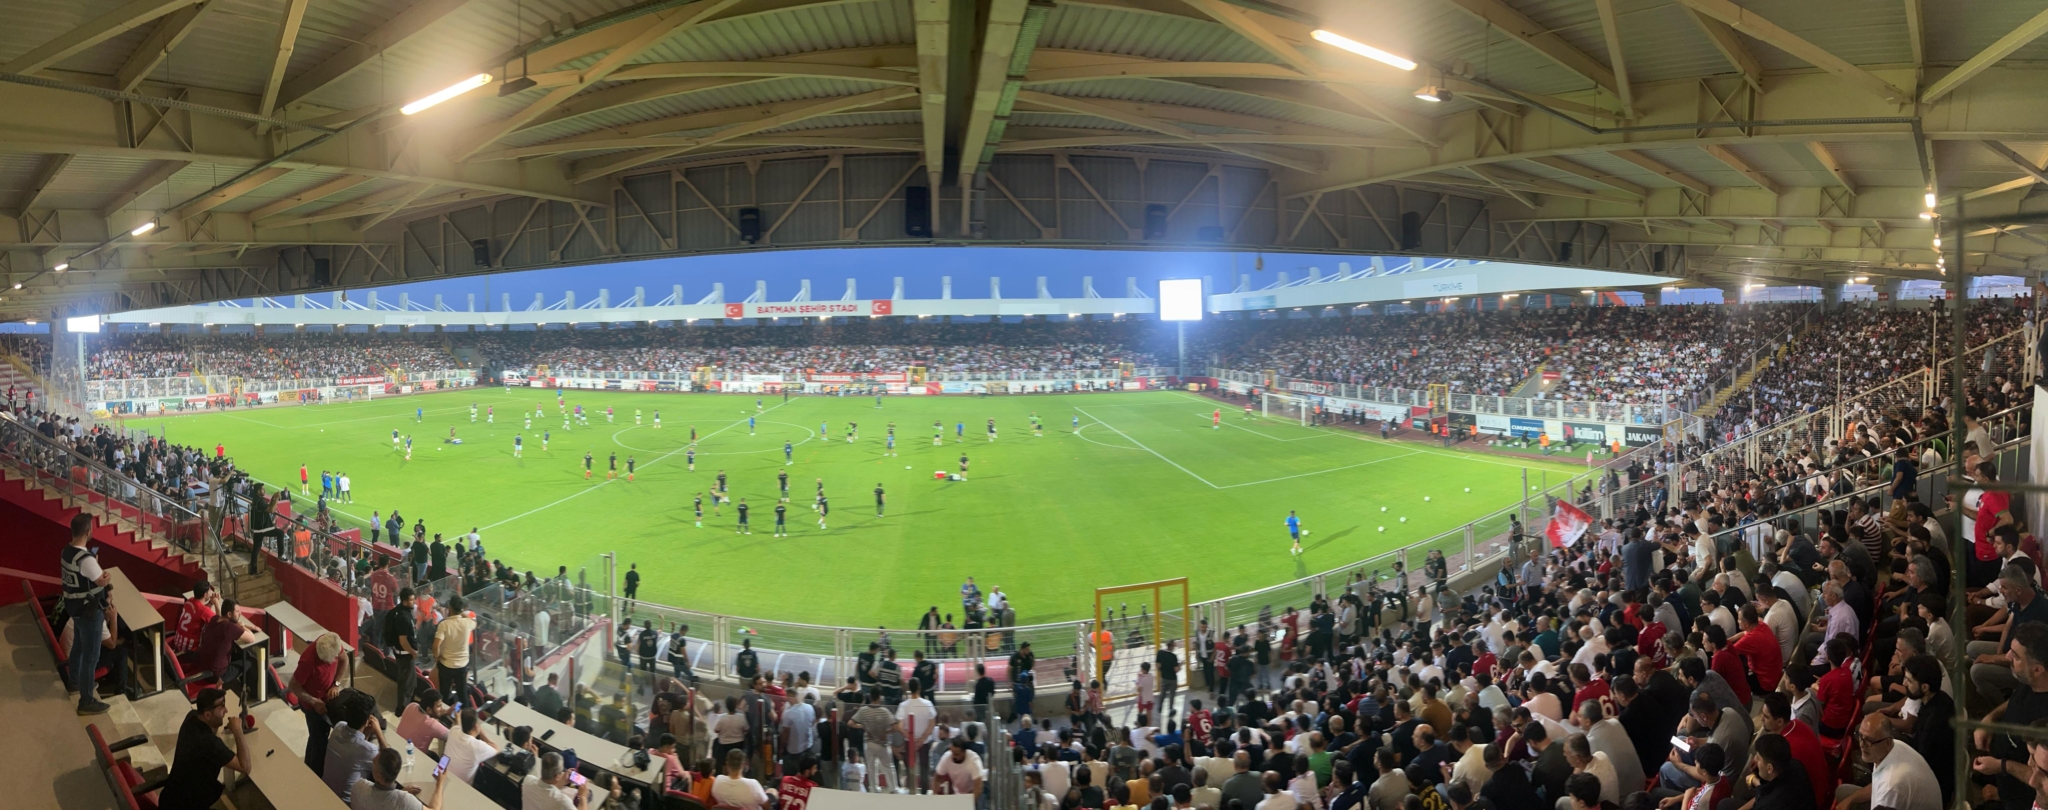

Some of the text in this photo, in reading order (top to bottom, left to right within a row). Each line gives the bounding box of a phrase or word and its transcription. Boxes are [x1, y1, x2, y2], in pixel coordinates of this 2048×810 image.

[757, 304, 858, 314] BATMAN ŞEHİR STADI
[372, 582, 388, 599] 49
[1599, 695, 1614, 719] 6
[1200, 718, 1212, 733] 6
